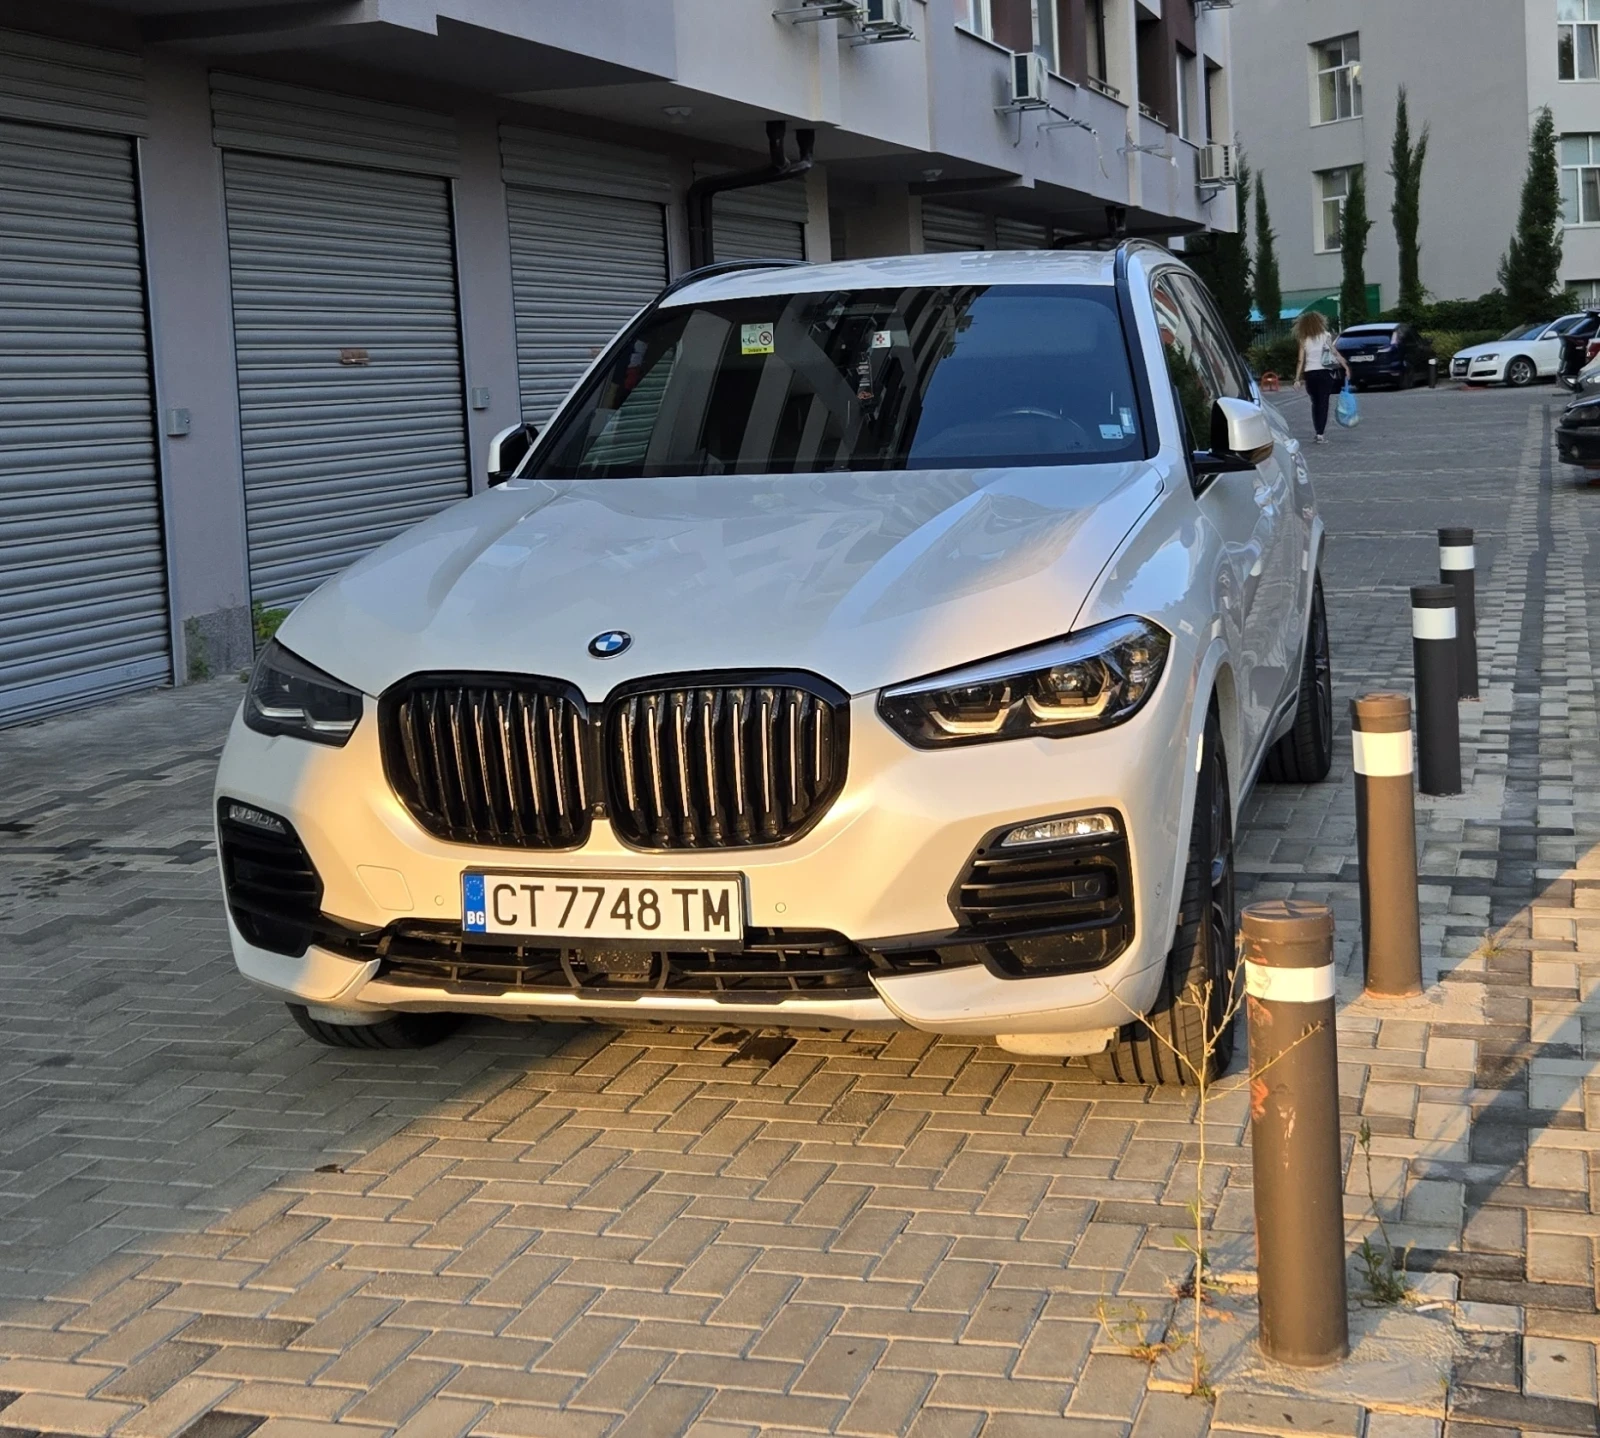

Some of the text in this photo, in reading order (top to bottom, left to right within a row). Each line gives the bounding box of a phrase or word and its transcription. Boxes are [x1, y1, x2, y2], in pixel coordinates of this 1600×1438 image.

[467, 910, 485, 925] BG
[492, 883, 731, 932] CT 7748 TM
